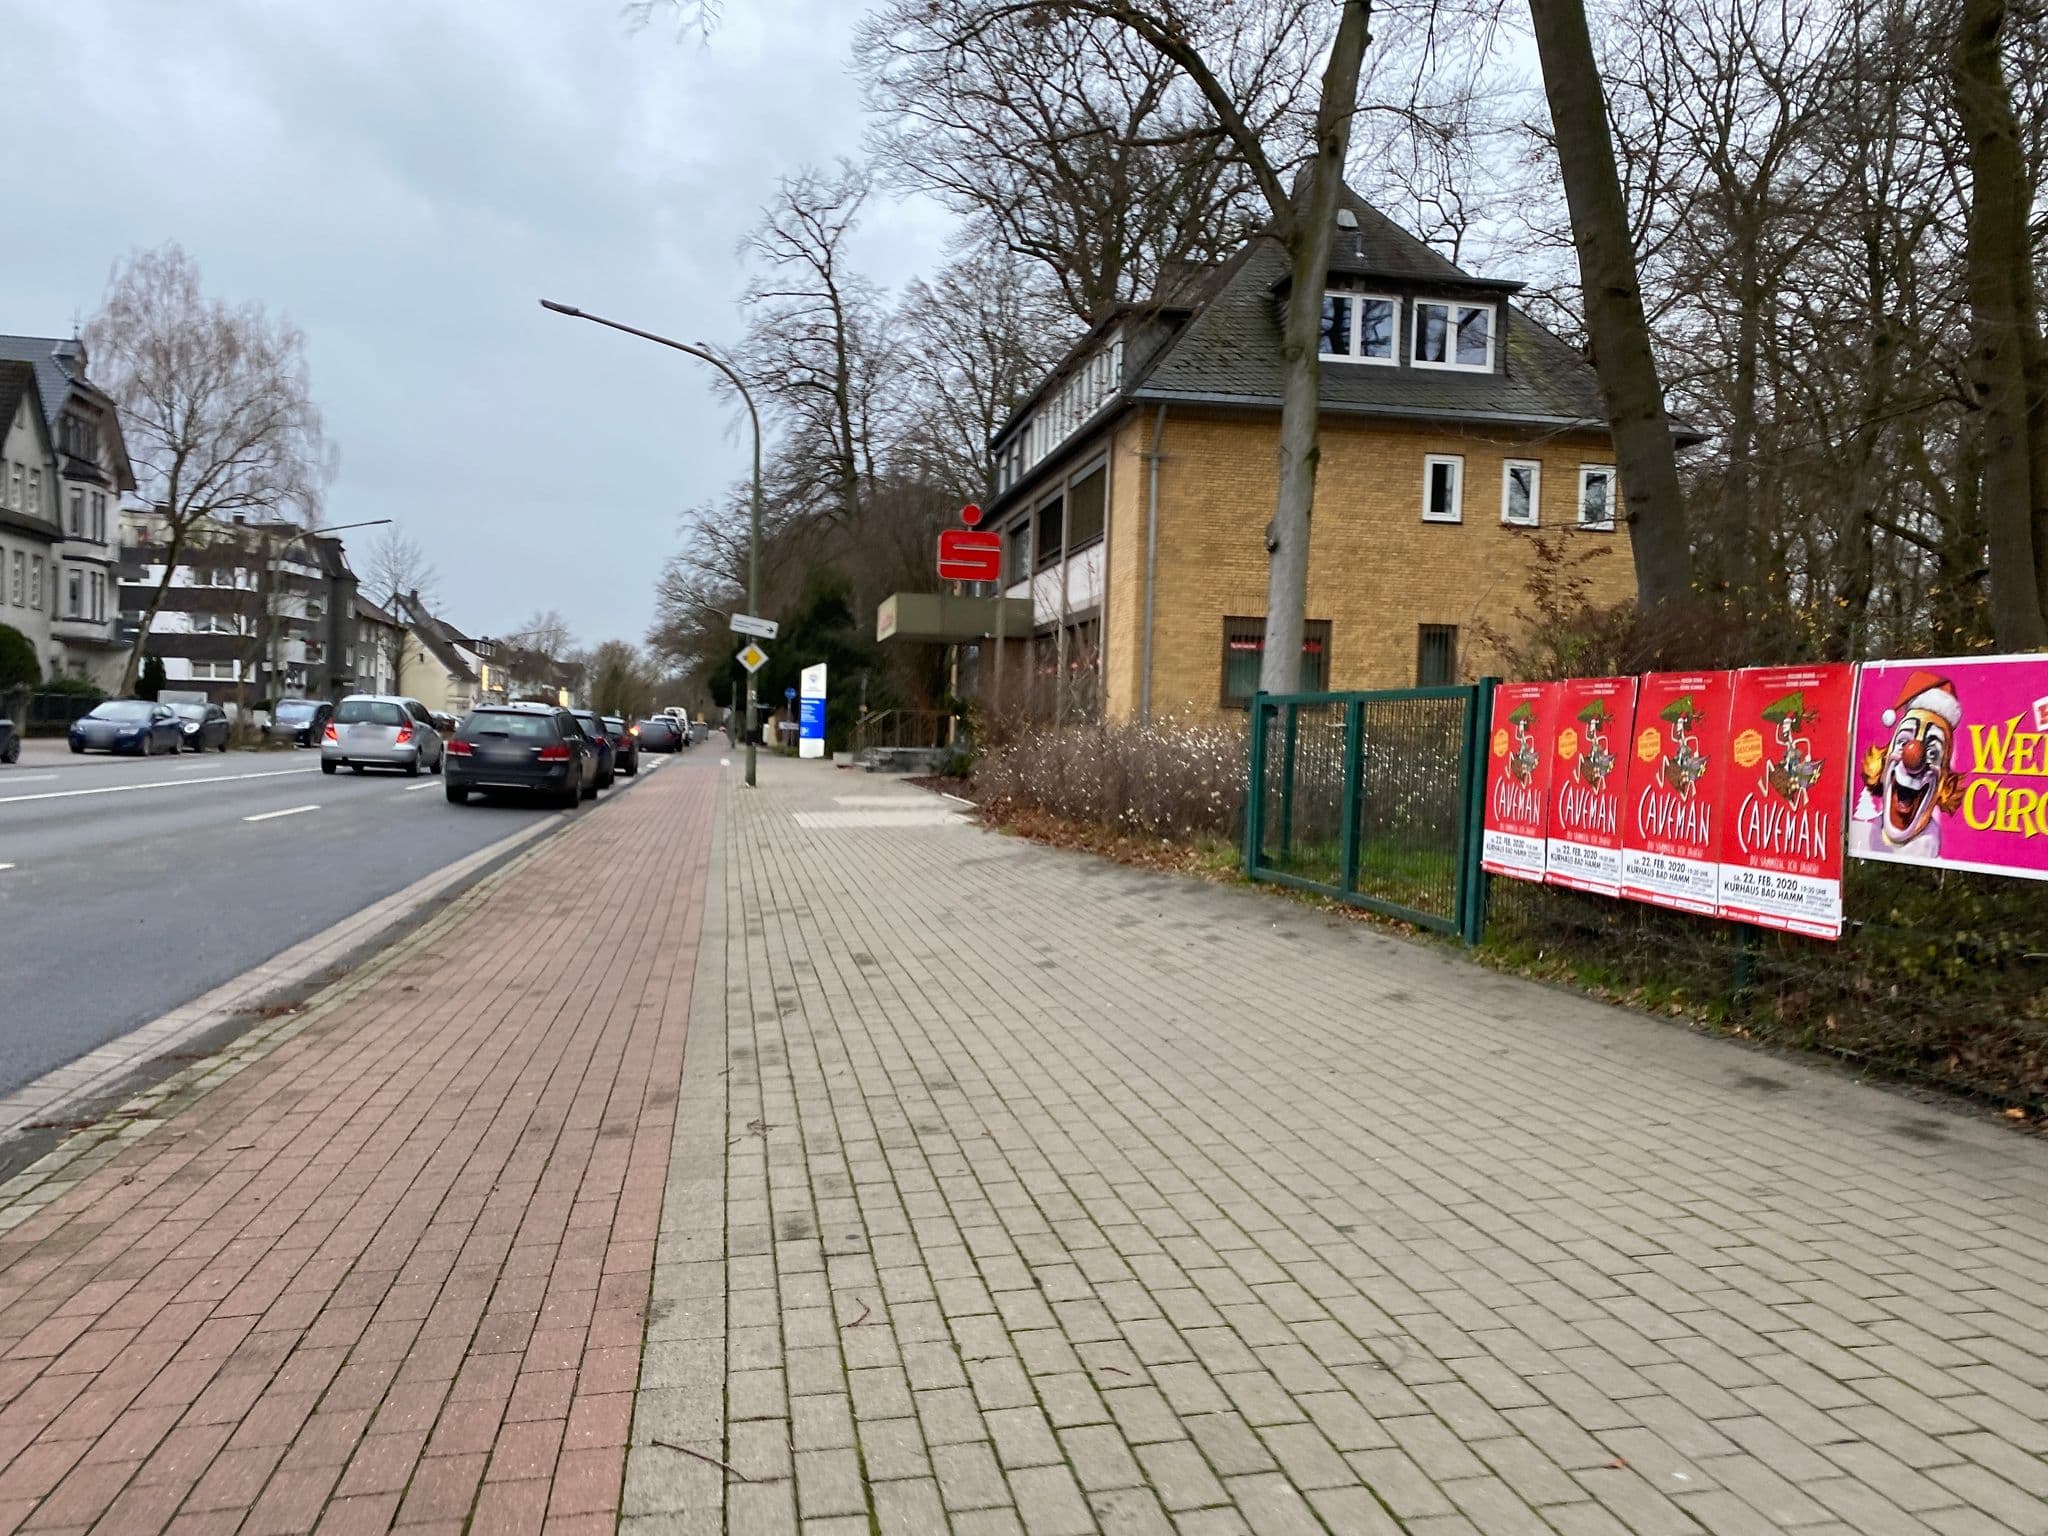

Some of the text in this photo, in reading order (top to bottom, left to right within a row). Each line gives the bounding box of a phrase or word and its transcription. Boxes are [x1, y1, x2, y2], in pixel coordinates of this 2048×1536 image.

[1494, 775, 1541, 826] CAVEMAN
[1559, 779, 1618, 835] CAVEMAN
[1638, 783, 1711, 847] CAVEMAN
[1737, 791, 1828, 861] CAVEMAN
[1550, 852, 1574, 865] KURHAUS
[1585, 858, 1601, 869] HAMM
[1583, 849, 1598, 860] 2020
[1642, 856, 1651, 867] 22.
[1654, 858, 1666, 869] FEB.
[1668, 860, 1686, 873] 2020
[1626, 863, 1655, 878] KURHAUS
[1656, 869, 1668, 880] BAD
[1669, 872, 1690, 884] HAMM
[1743, 872, 1755, 884] 22.
[1757, 874, 1773, 887] FEB.
[1776, 877, 1798, 891] 2020
[1724, 881, 1760, 896] KURHAUS
[1761, 887, 1776, 899] BAD
[1777, 890, 1804, 904] HAMM
